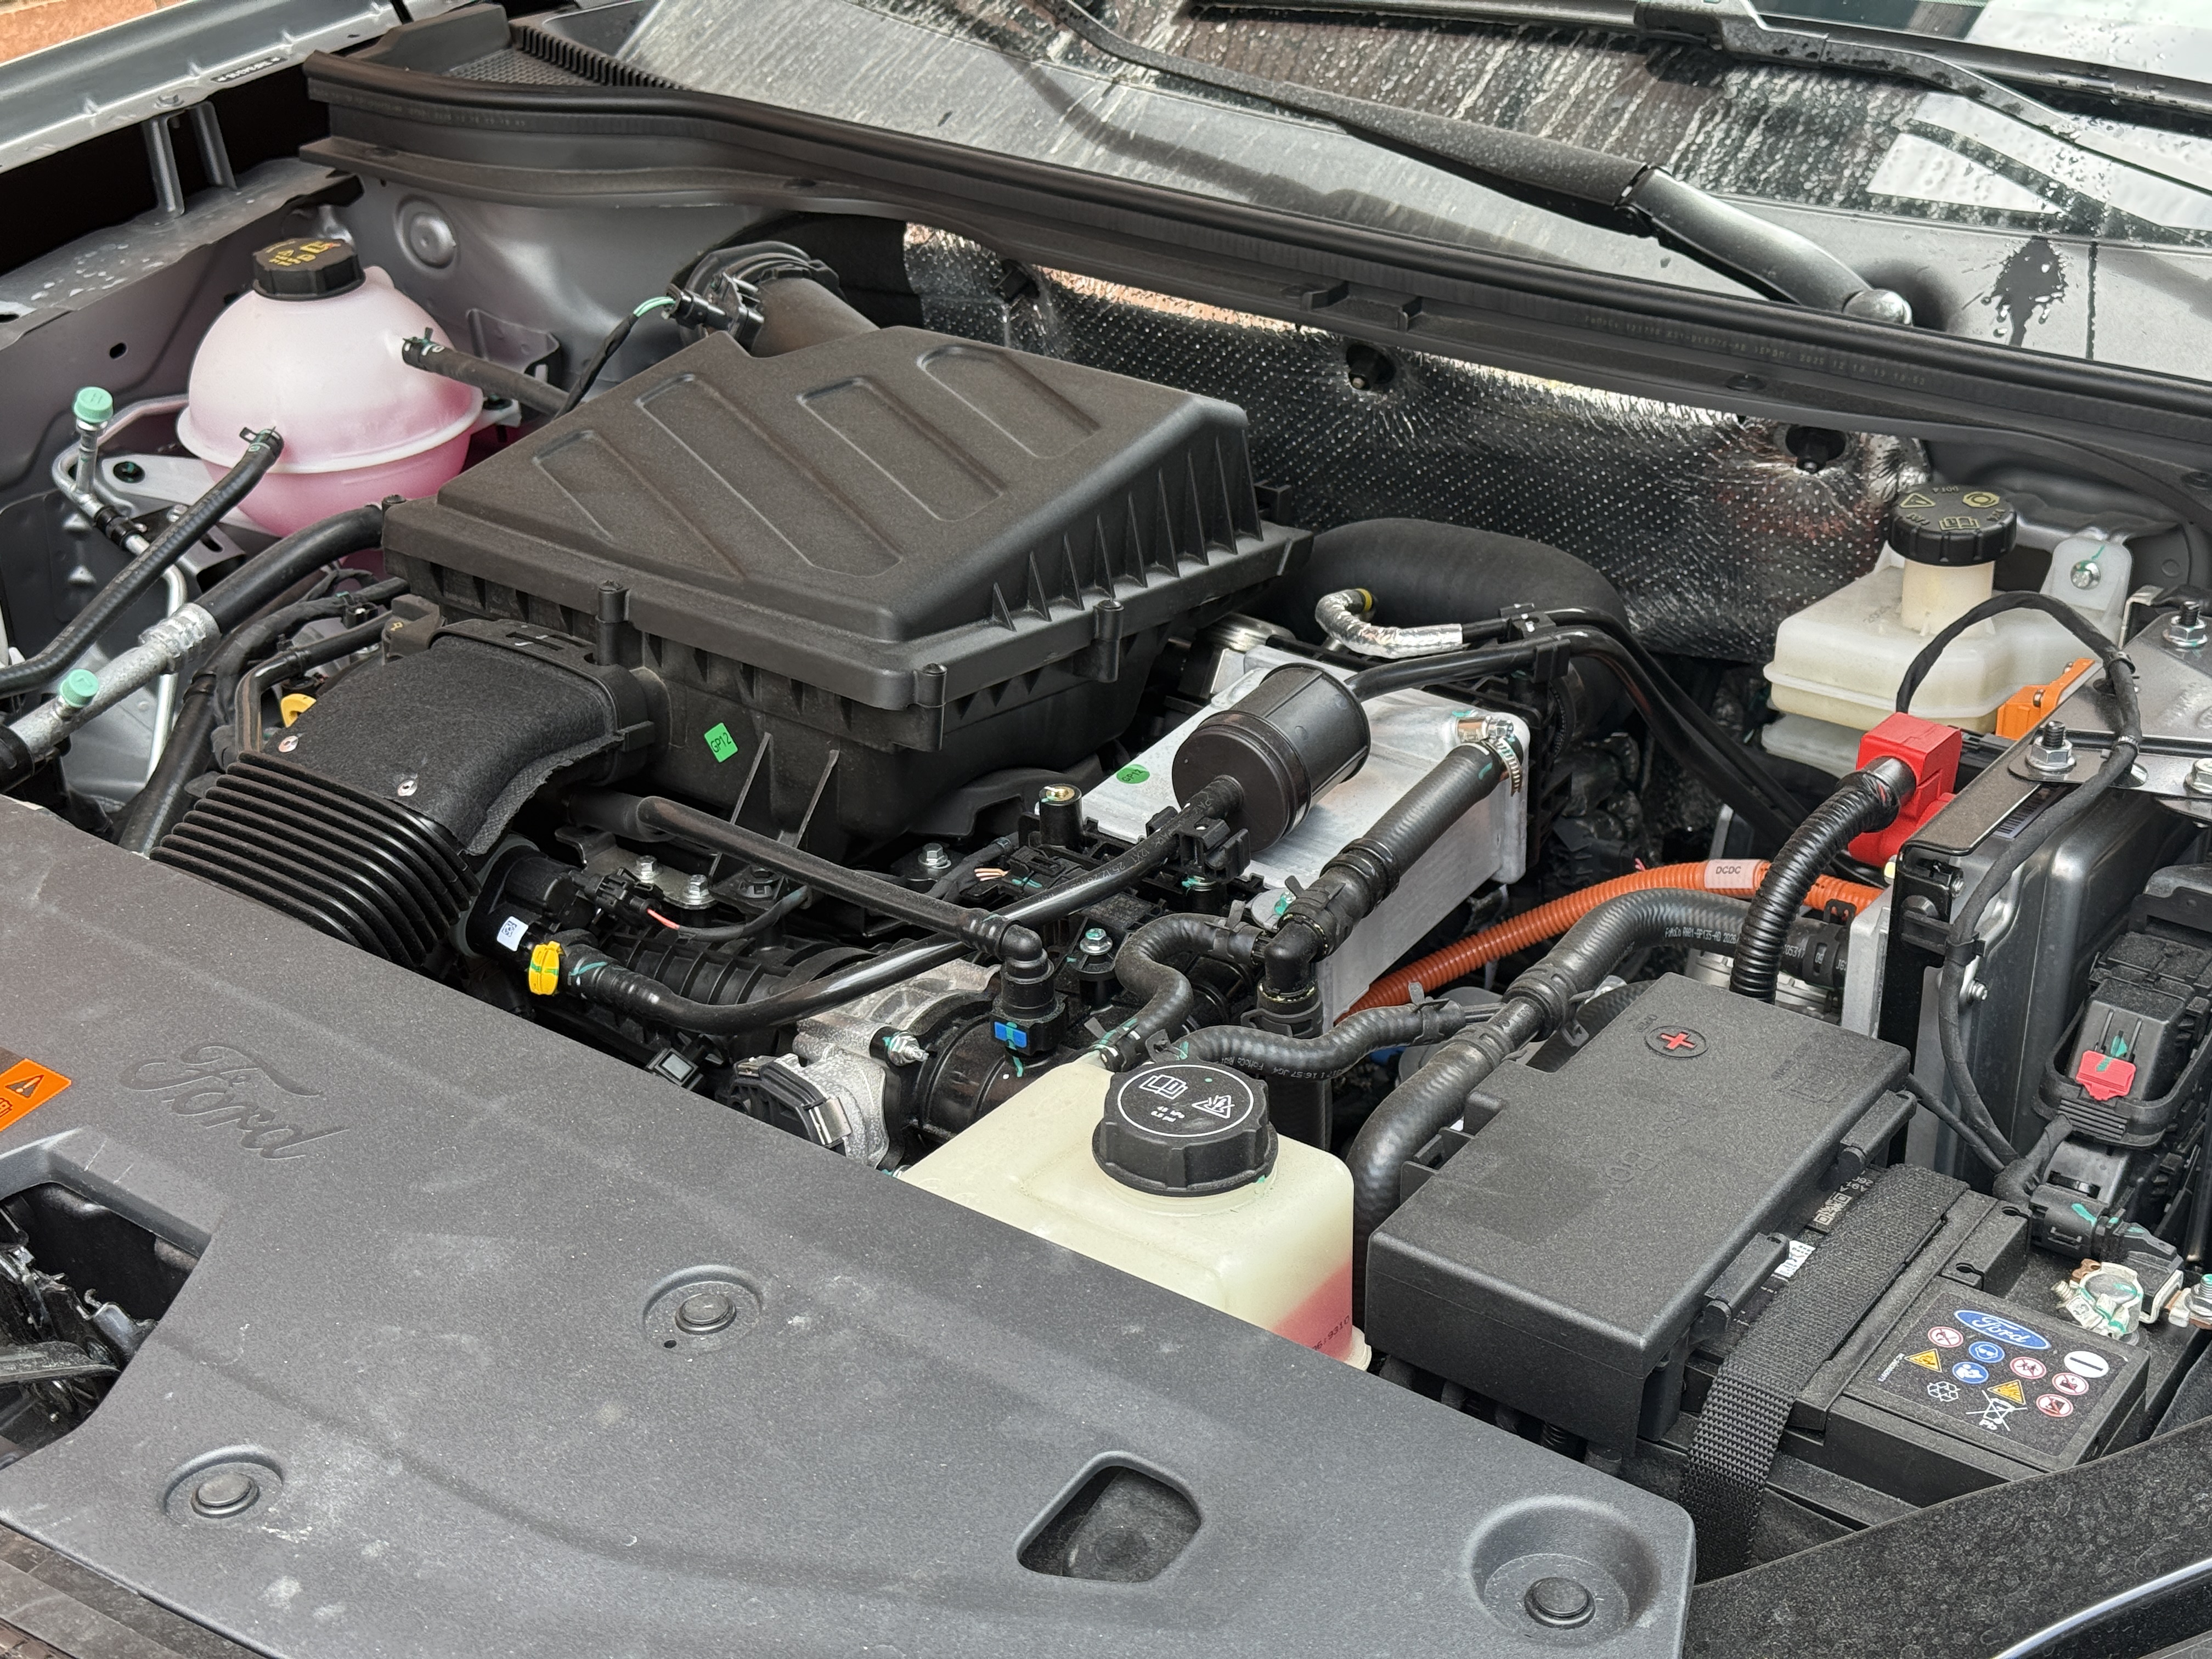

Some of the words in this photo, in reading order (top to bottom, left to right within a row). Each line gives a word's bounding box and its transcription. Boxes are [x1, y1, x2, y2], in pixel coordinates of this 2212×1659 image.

[710, 732, 732, 753] GP12
[1121, 769, 1144, 782] GP12
[1716, 865, 1741, 875] DCDC
[1237, 1057, 1264, 1071] FoMoCo
[120, 1042, 351, 1161] Ford
[1976, 1315, 2033, 1345] Ford
